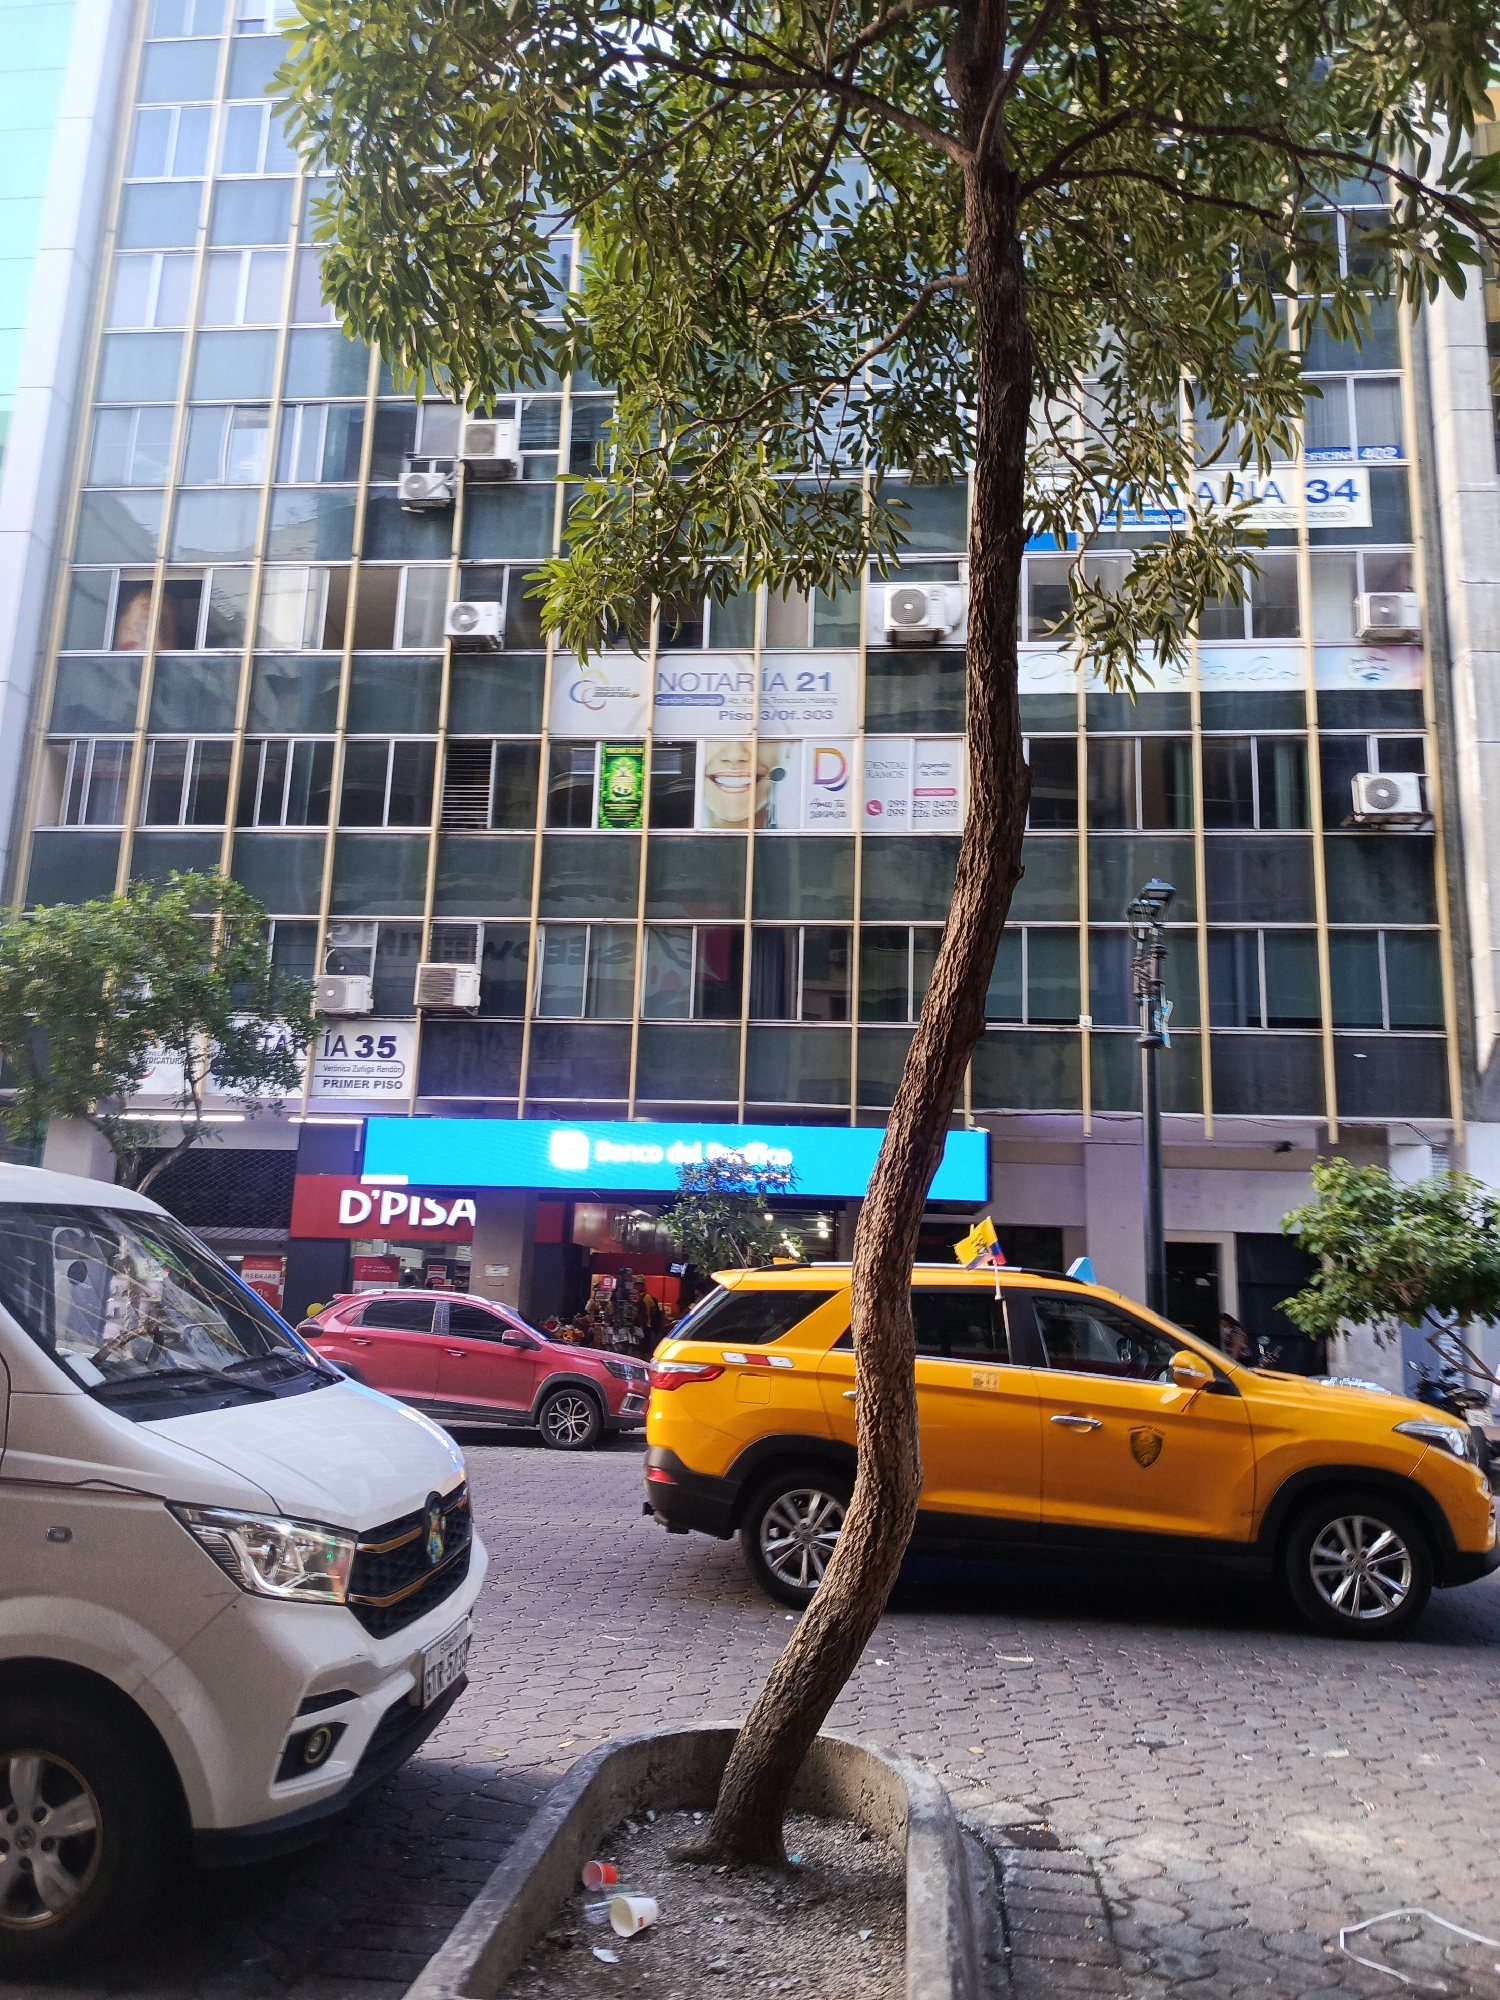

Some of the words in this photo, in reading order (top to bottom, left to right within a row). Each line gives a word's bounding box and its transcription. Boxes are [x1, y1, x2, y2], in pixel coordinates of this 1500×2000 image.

[1360, 447, 1398, 460] 402
[1307, 479, 1360, 504] 34
[795, 671, 832, 692] 21
[354, 1034, 397, 1059] 35
[323, 1080, 370, 1089] PRIMER
[373, 1081, 403, 1090] PISO
[595, 1141, 663, 1163] Banco
